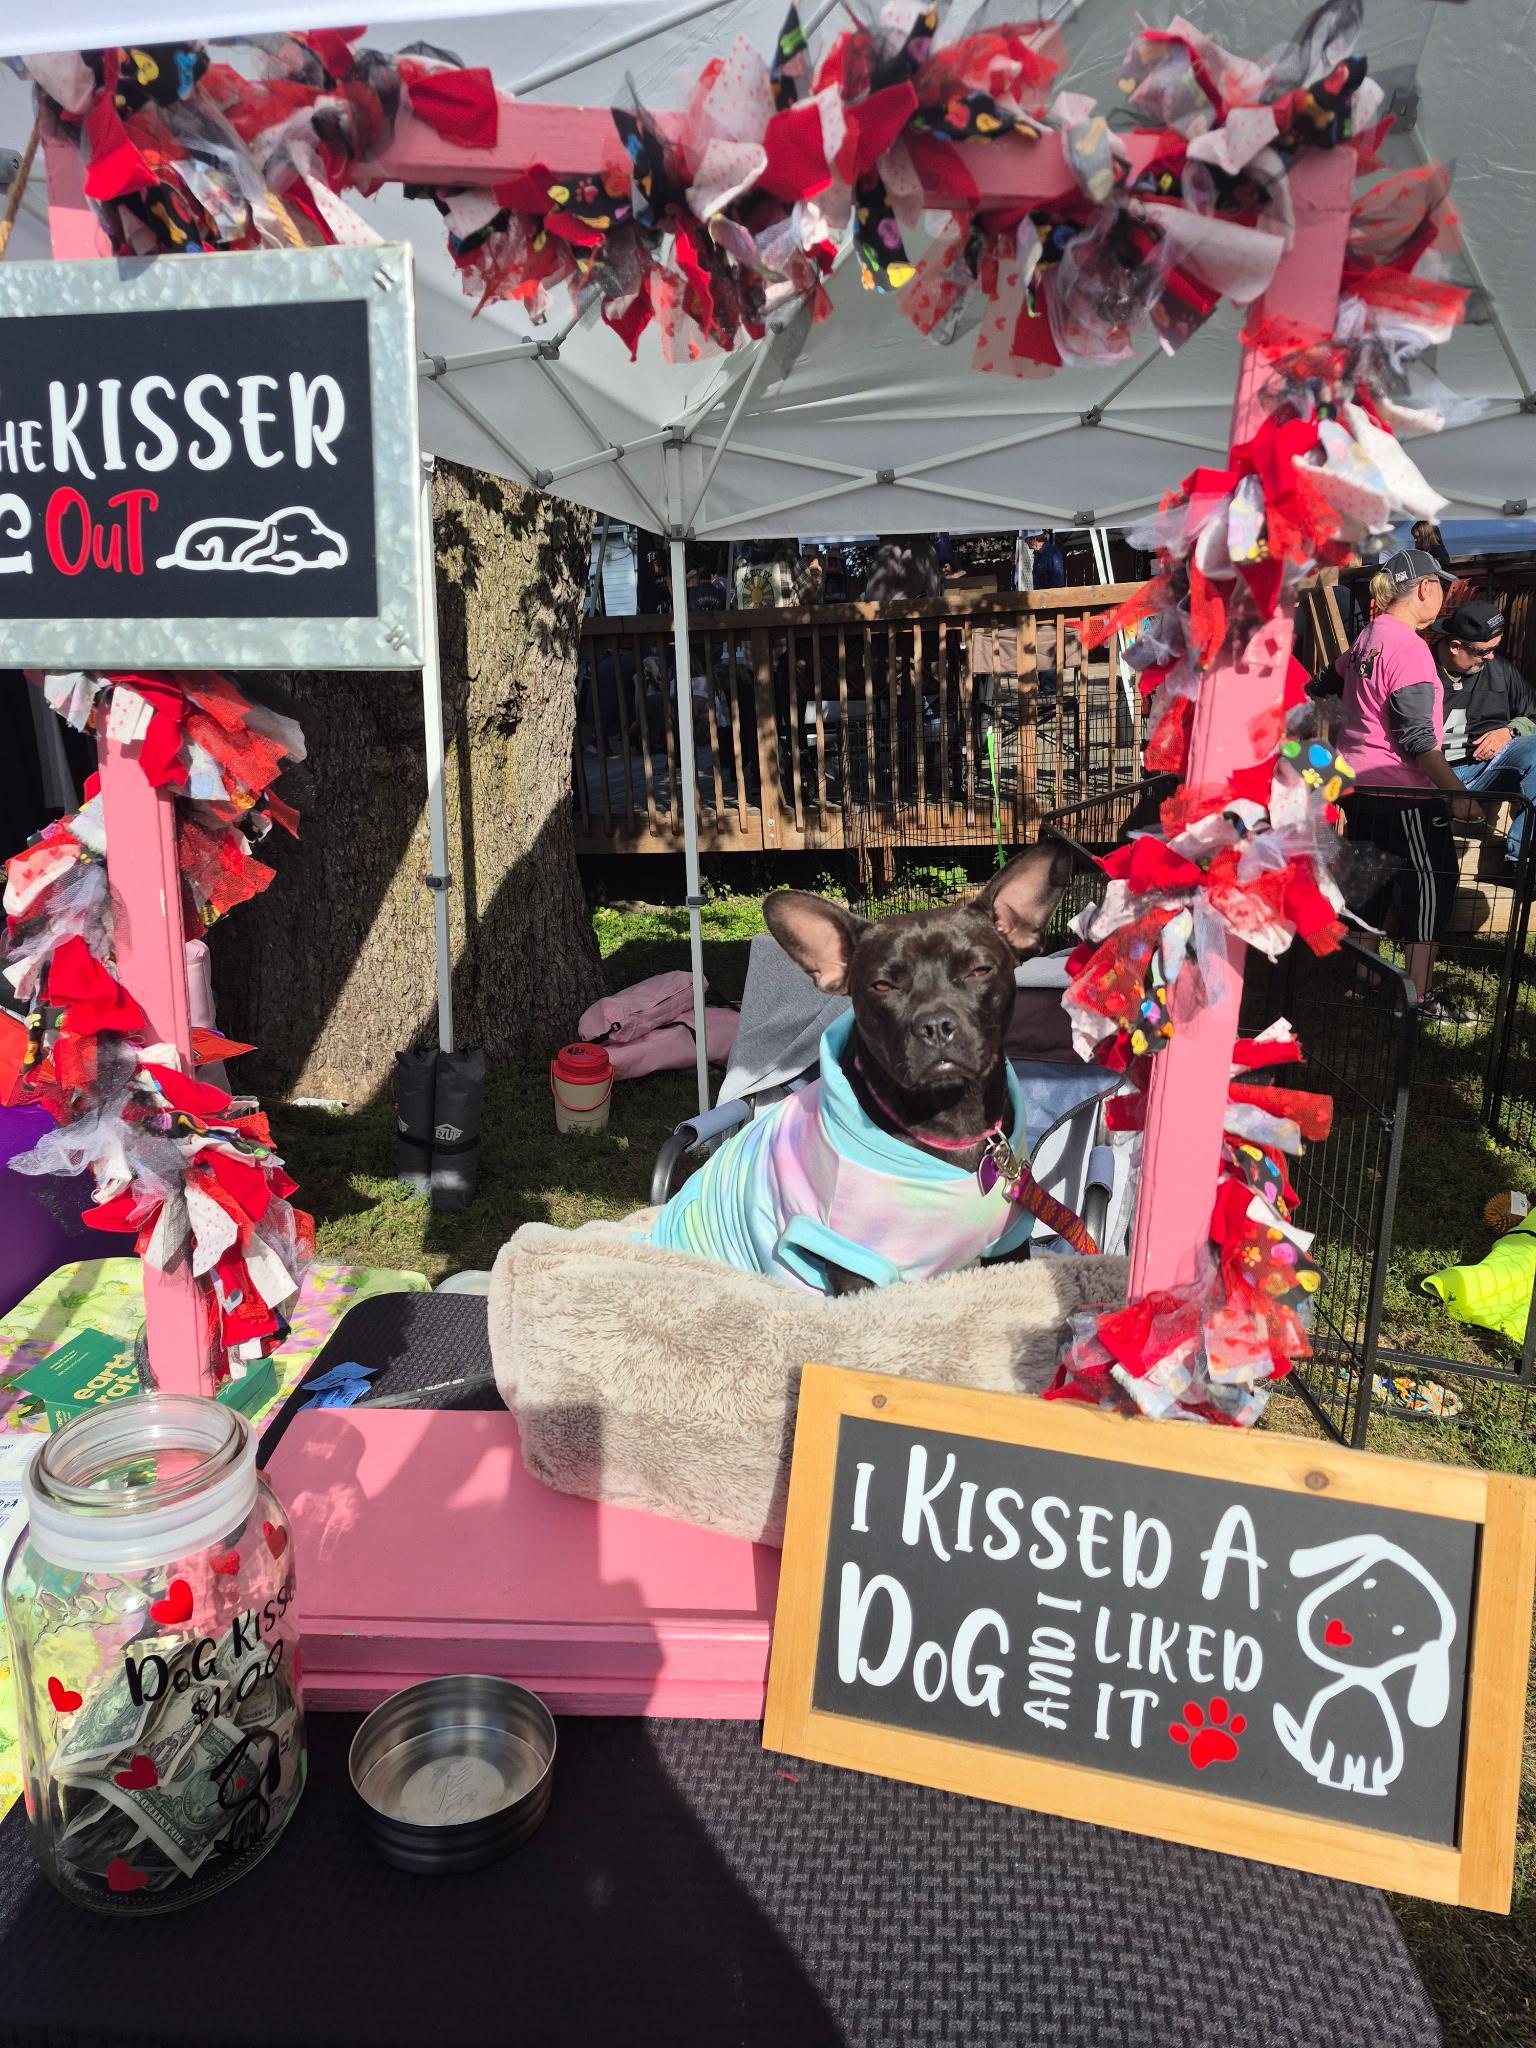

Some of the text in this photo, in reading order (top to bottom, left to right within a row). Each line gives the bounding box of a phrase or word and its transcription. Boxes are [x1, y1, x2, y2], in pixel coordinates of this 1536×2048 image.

[48, 371, 346, 480] KISSER
[850, 1444, 1269, 1611] I KISSED A
[190, 1639, 284, 1728] $1.00
[1022, 1591, 1083, 1732] AND I
[1094, 1605, 1264, 1693] LIKED
[1093, 1682, 1160, 1749] IT
